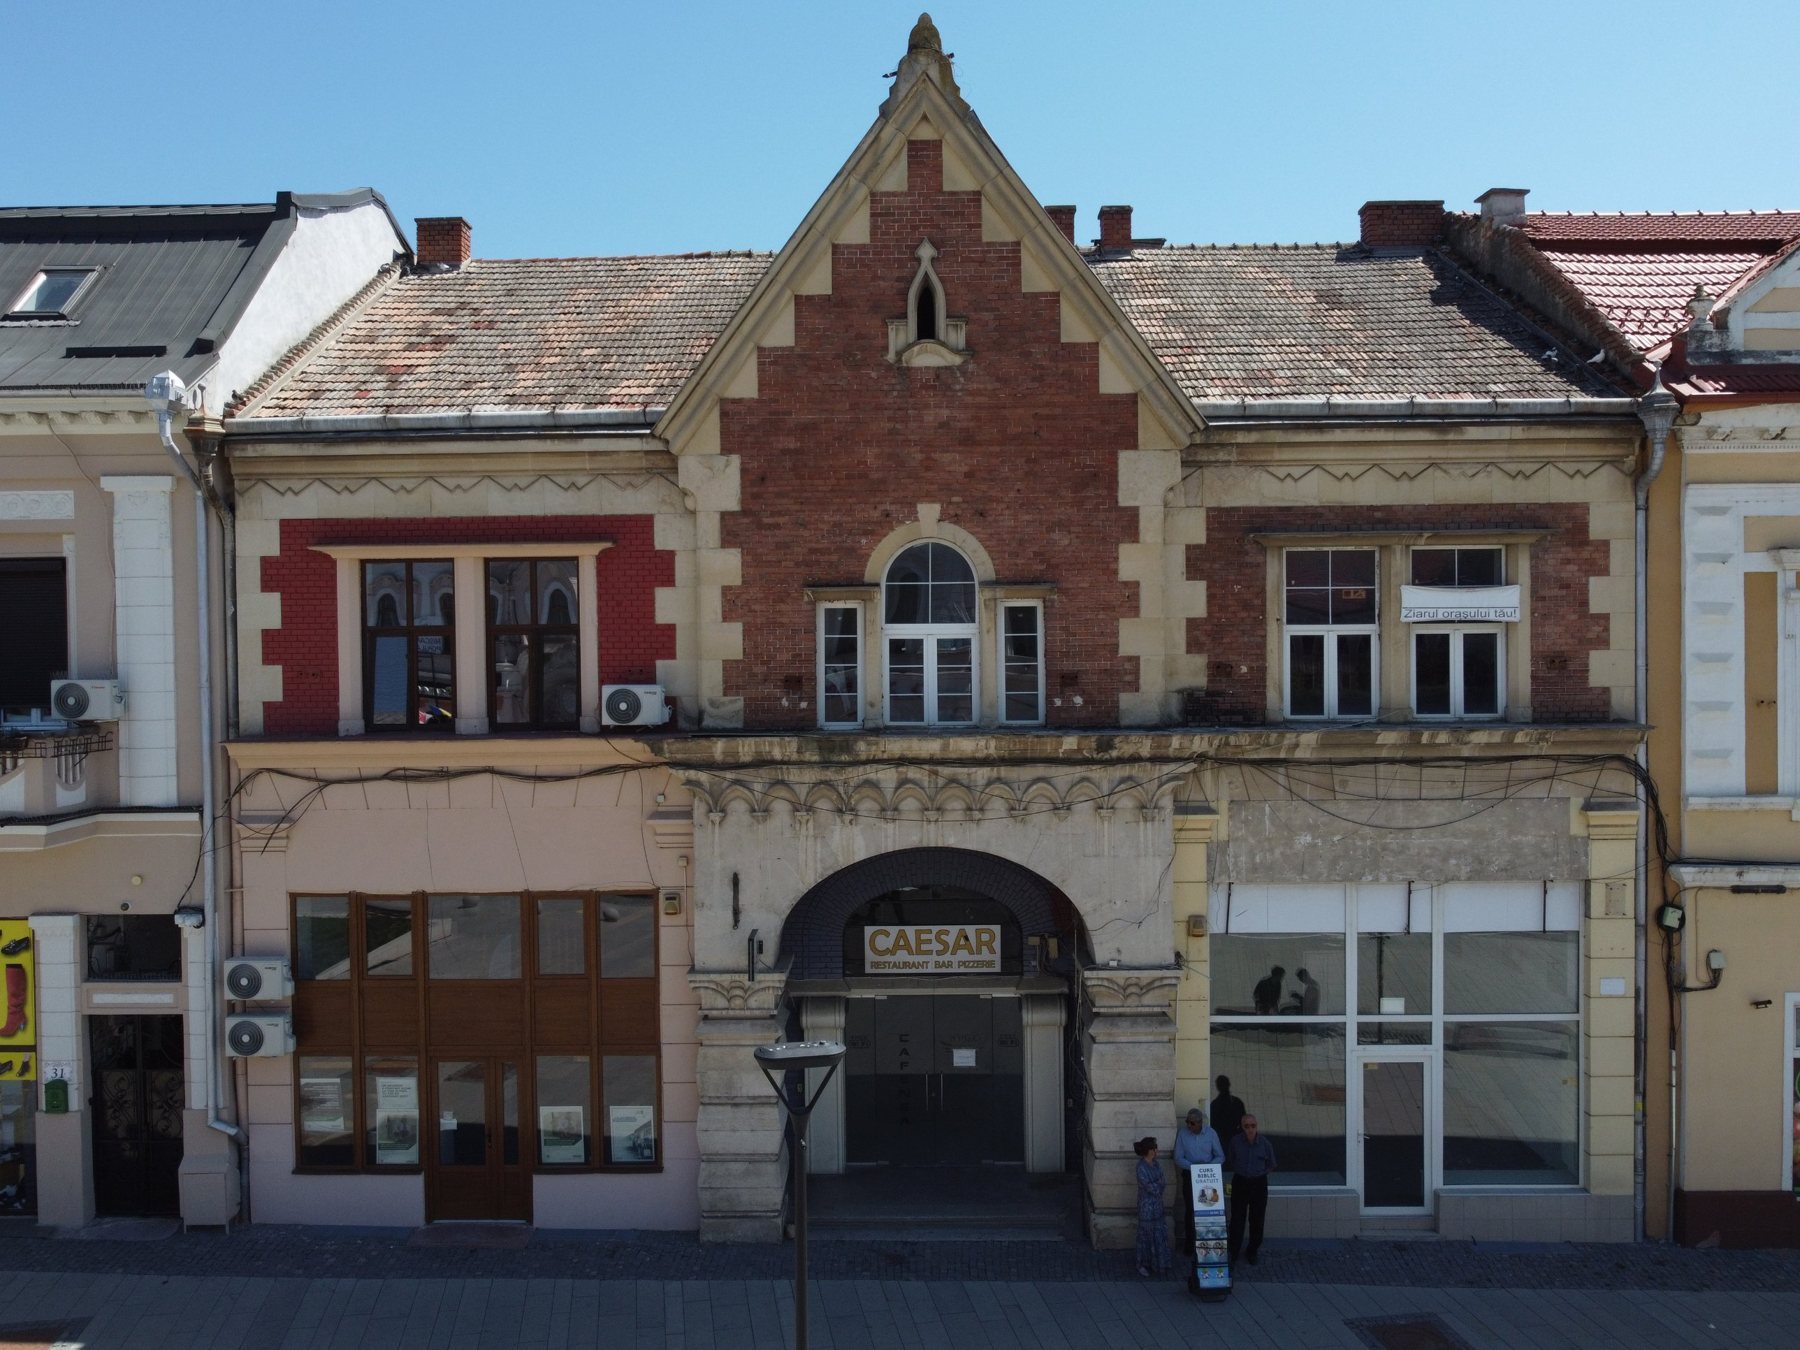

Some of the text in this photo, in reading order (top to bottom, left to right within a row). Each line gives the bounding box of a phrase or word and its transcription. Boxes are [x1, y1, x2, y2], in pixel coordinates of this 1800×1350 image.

[1404, 608, 1439, 618] Ziarul
[1494, 608, 1517, 618] tău!
[869, 928, 996, 956] CAESAR
[870, 960, 996, 970] RESTAURANT BAR PIZZERIE
[51, 1068, 64, 1078] 31
